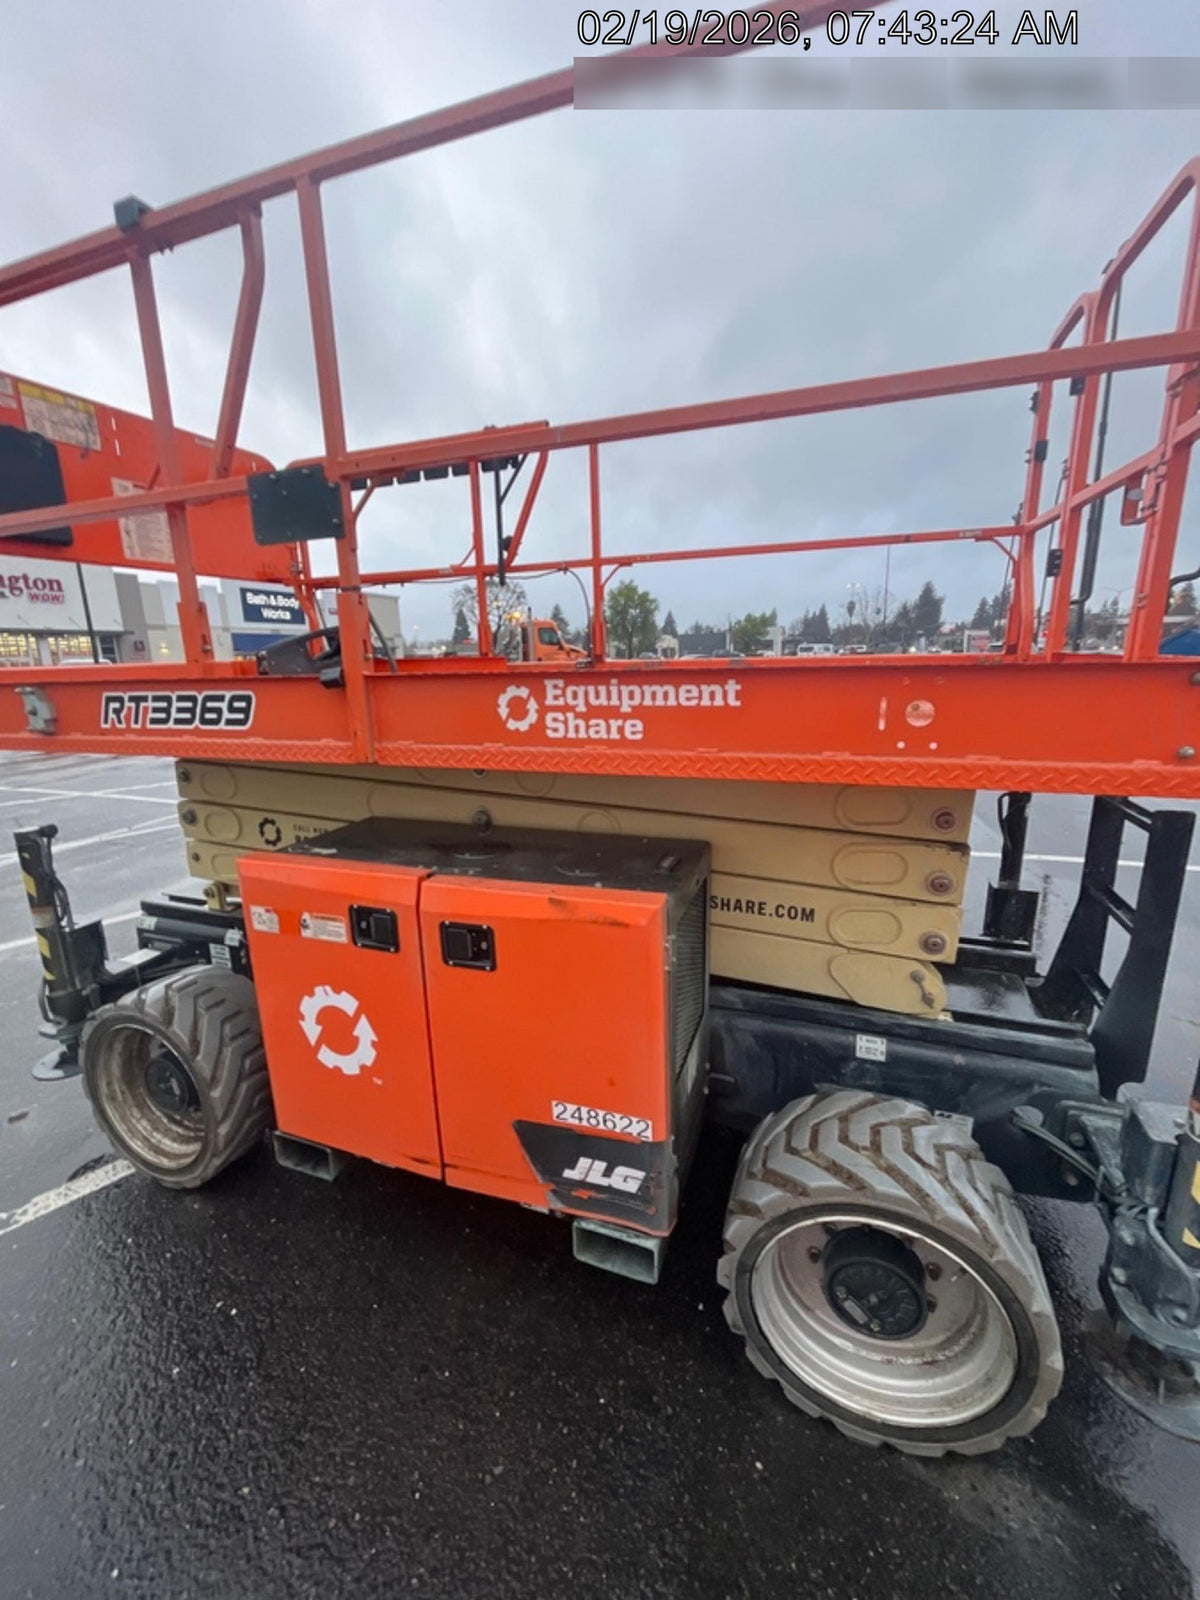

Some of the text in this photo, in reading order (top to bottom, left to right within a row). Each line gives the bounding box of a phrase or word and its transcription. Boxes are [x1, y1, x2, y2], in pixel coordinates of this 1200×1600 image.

[101, 691, 255, 730] RT3369
[544, 678, 742, 713] Equipment
[544, 711, 645, 741] Share
[709, 895, 816, 923] SHARE.COM
[554, 1101, 651, 1140] 248622
[562, 1156, 646, 1194] JLG
